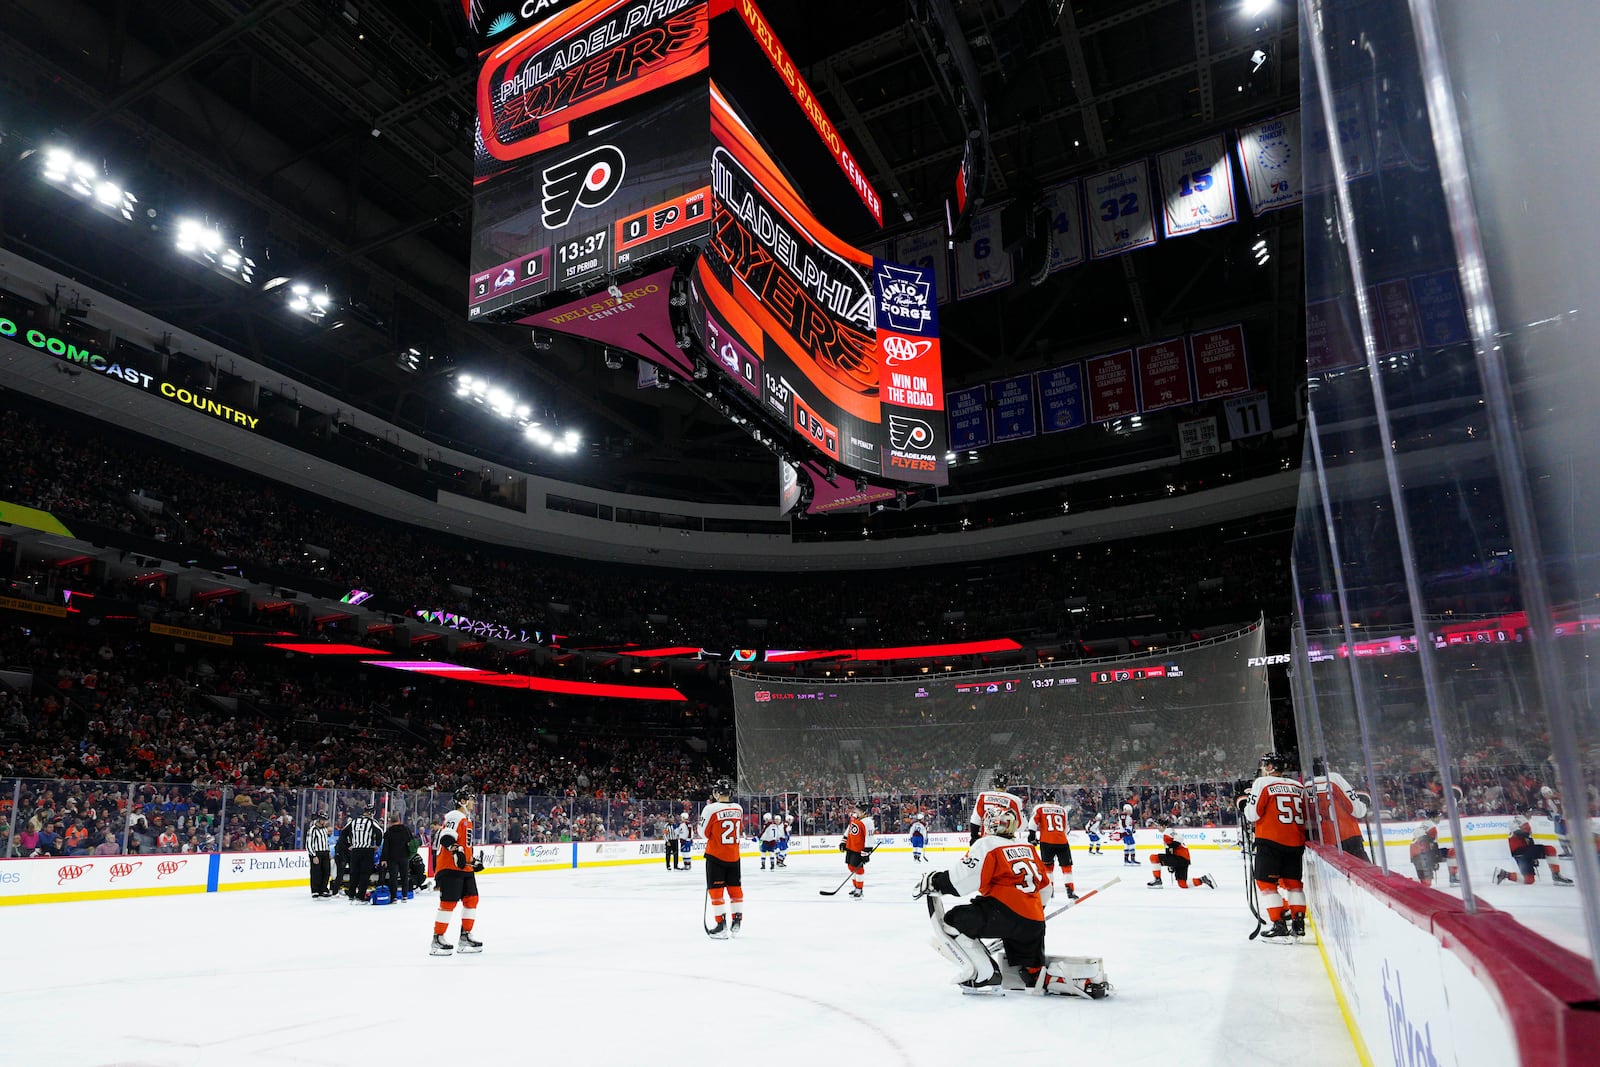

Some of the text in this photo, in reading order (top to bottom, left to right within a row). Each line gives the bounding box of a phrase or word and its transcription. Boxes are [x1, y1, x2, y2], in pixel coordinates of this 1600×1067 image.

[500, 0, 688, 102] PHILADELPH
[743, 0, 880, 217] WELLS FARGO CENTER
[1179, 167, 1213, 198] 15
[1270, 180, 1289, 194] 76
[685, 193, 704, 204] SHOTS
[691, 204, 698, 216] 1
[1100, 193, 1139, 222] 32
[630, 220, 640, 238] 0
[559, 230, 607, 264] 13:37
[974, 237, 991, 259] 6
[618, 252, 630, 264] PEN
[527, 260, 536, 276] 0
[566, 258, 598, 277] 1ST PERIOD
[479, 284, 486, 295] 3
[882, 282, 927, 307] UNION
[470, 306, 481, 317] PEN
[549, 284, 659, 324] WELLS FARGO
[588, 302, 636, 322] CENTER
[881, 302, 931, 321] FORGE
[886, 340, 917, 359] AAA
[26, 329, 154, 388] COMCAST
[160, 382, 260, 429] COUNTRY
[745, 362, 752, 380] 0
[765, 373, 789, 403] 13:37
[891, 372, 928, 391] WIN ON
[887, 386, 934, 407] THE ROAD
[799, 410, 806, 426] 0
[1236, 403, 1261, 434] 11
[890, 450, 937, 462] PHILADELPHIA
[891, 456, 937, 471] FLYERS
[1247, 653, 1291, 668] FLYERS
[1005, 682, 1012, 690] 0
[1031, 678, 1054, 688] 13:37
[1101, 673, 1107, 682] 0
[718, 811, 741, 819] LAUGHTO
[1046, 814, 1064, 832] 19
[721, 820, 741, 845] 21
[534, 845, 560, 858] Sports
[639, 843, 649, 854] PLAY
[111, 864, 132, 877] AAA
[158, 862, 178, 874] AAA
[249, 856, 310, 870] Penn Medic
[60, 866, 82, 879] AAA
